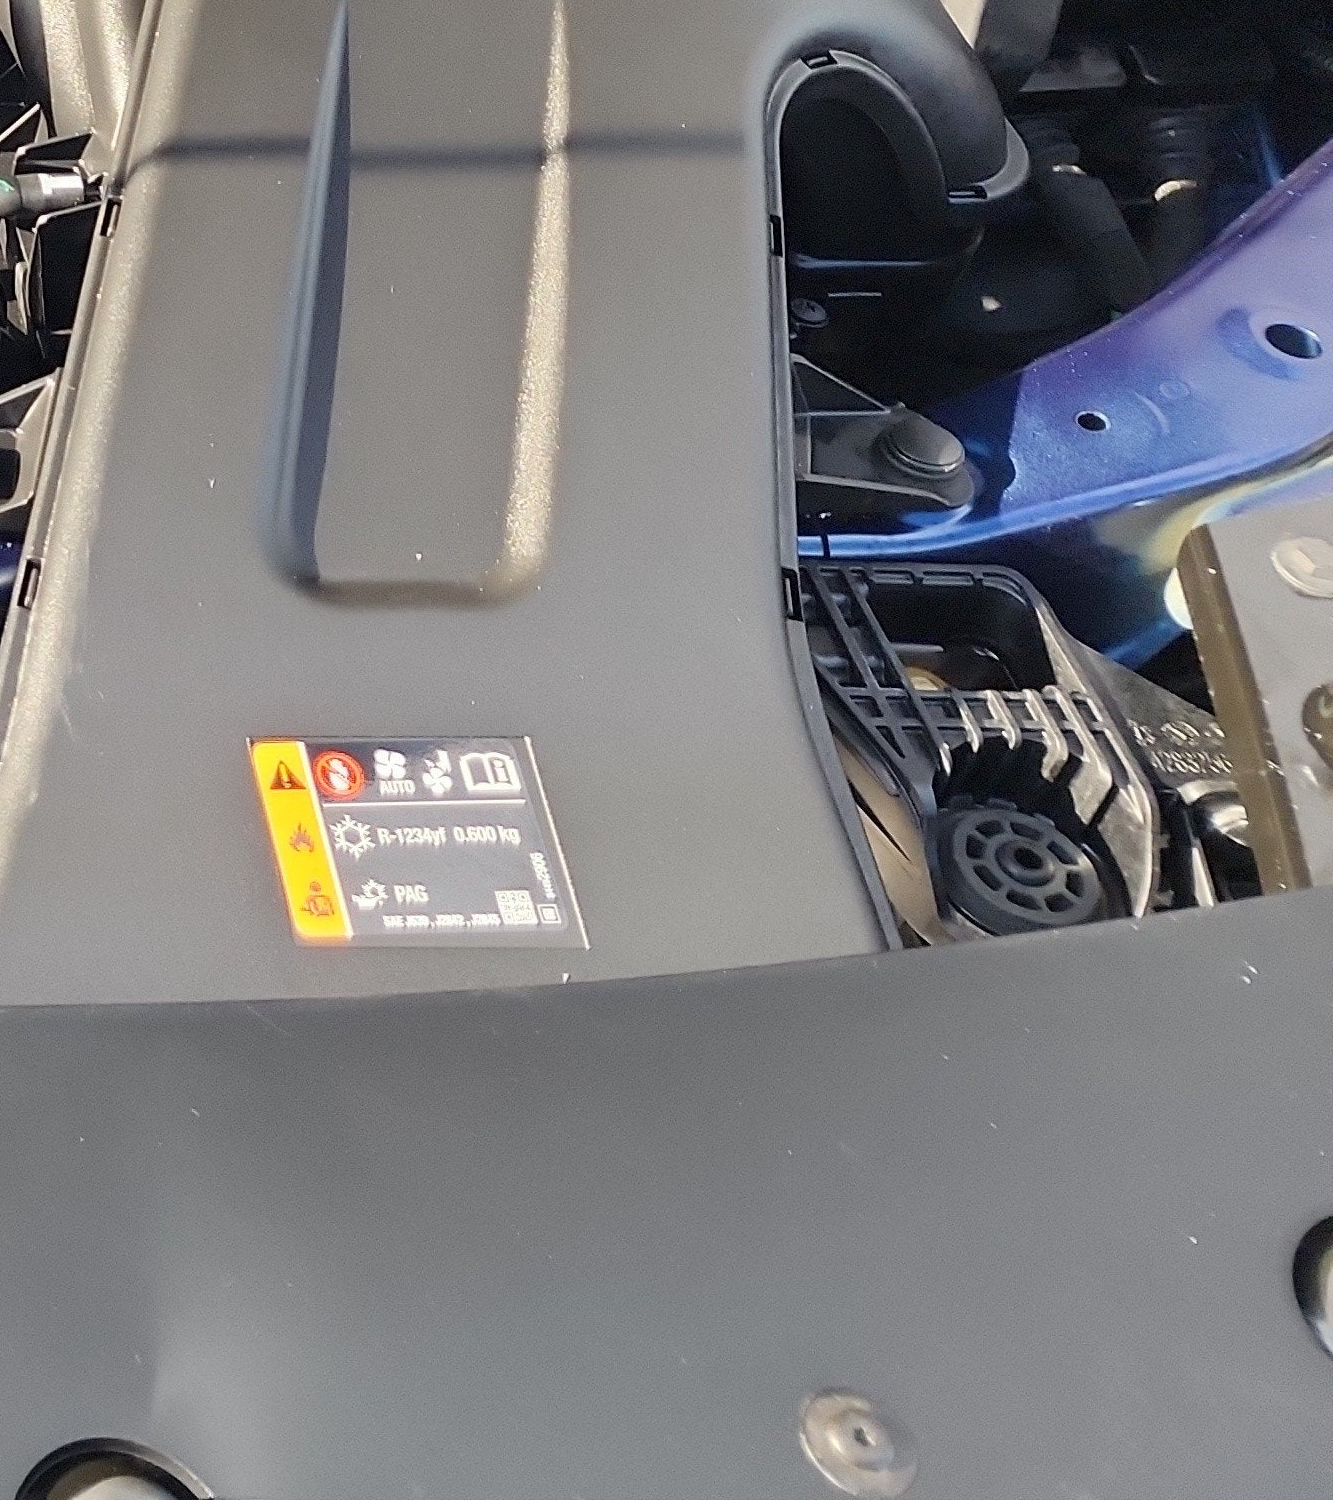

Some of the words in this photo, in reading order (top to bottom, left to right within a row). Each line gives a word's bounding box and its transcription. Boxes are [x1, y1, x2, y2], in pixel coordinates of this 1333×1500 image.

[379, 779, 416, 796] AUTO
[377, 826, 447, 848] R-1234yf
[453, 825, 497, 843] 0.600
[498, 825, 520, 845] kg
[393, 885, 429, 904] PAG
